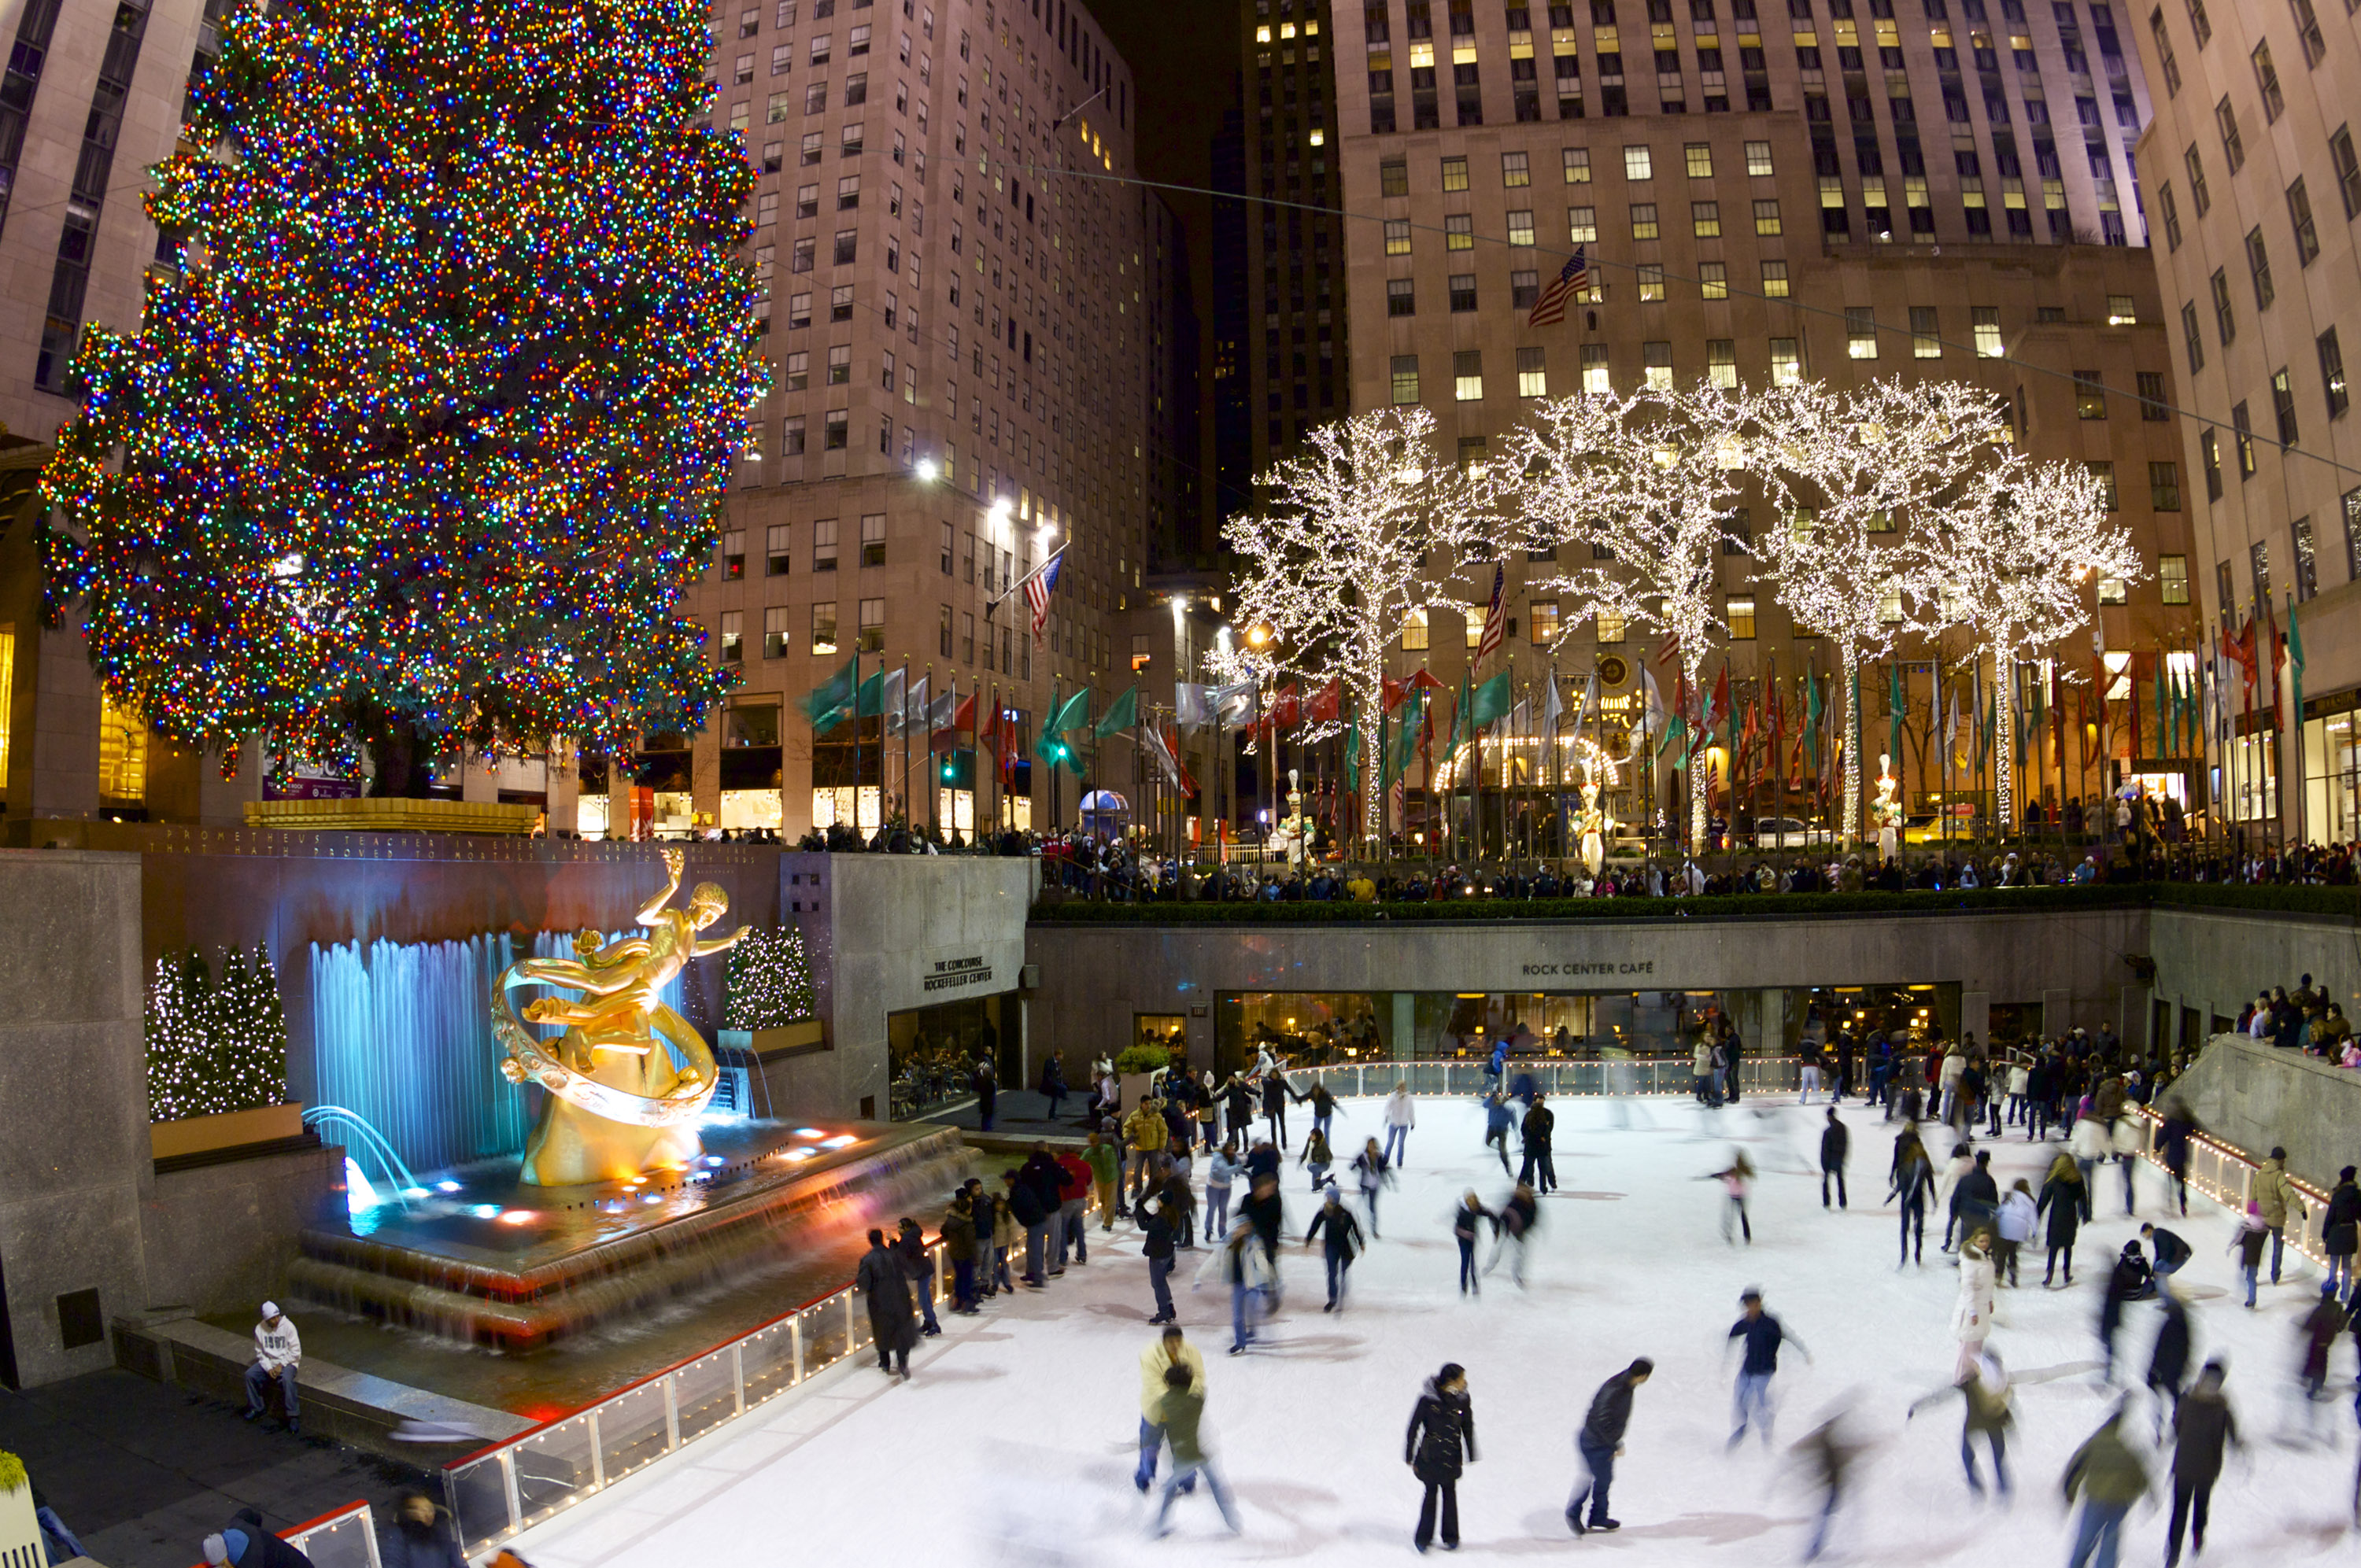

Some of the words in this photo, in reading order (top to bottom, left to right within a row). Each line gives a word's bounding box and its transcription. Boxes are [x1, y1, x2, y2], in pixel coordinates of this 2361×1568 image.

[167, 829, 320, 844] PROMETHEUS
[345, 836, 434, 847] TEACHER
[456, 839, 473, 849] IN
[493, 840, 545, 850] EVERY
[150, 843, 207, 854] THAT
[235, 844, 289, 857] HATH
[314, 847, 394, 859] PROVED
[416, 850, 434, 859] TO
[454, 850, 534, 861] MORTALS
[934, 961, 948, 972] THE
[948, 956, 983, 971] CONCOURSE
[1523, 965, 1559, 976] ROCK
[1563, 964, 1614, 975] CENTER
[1619, 961, 1653, 974] CAFÉ
[924, 975, 968, 991] ROCKEFELLER
[969, 971, 992, 984] CENTER
